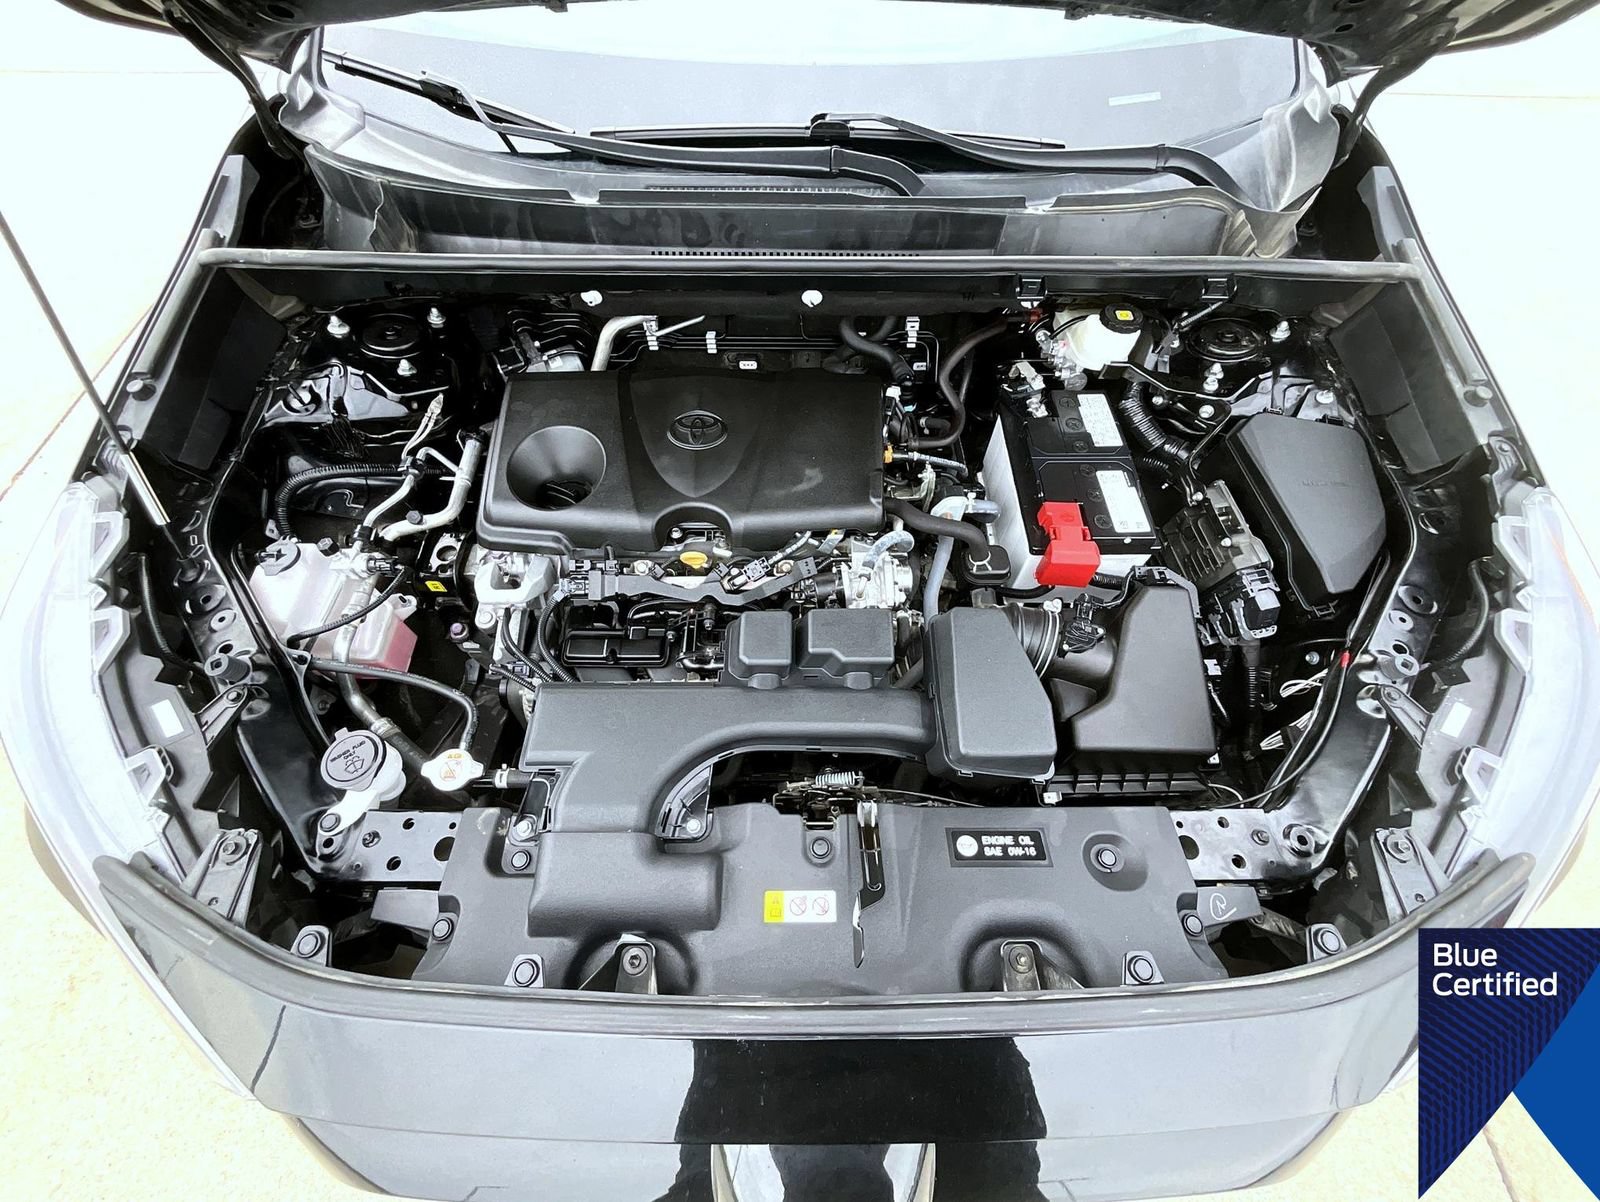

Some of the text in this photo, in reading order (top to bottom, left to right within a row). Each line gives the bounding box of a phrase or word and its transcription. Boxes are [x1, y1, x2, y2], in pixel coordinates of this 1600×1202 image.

[981, 835, 1034, 845] ENGINE OIL
[983, 846, 1003, 856] SAE
